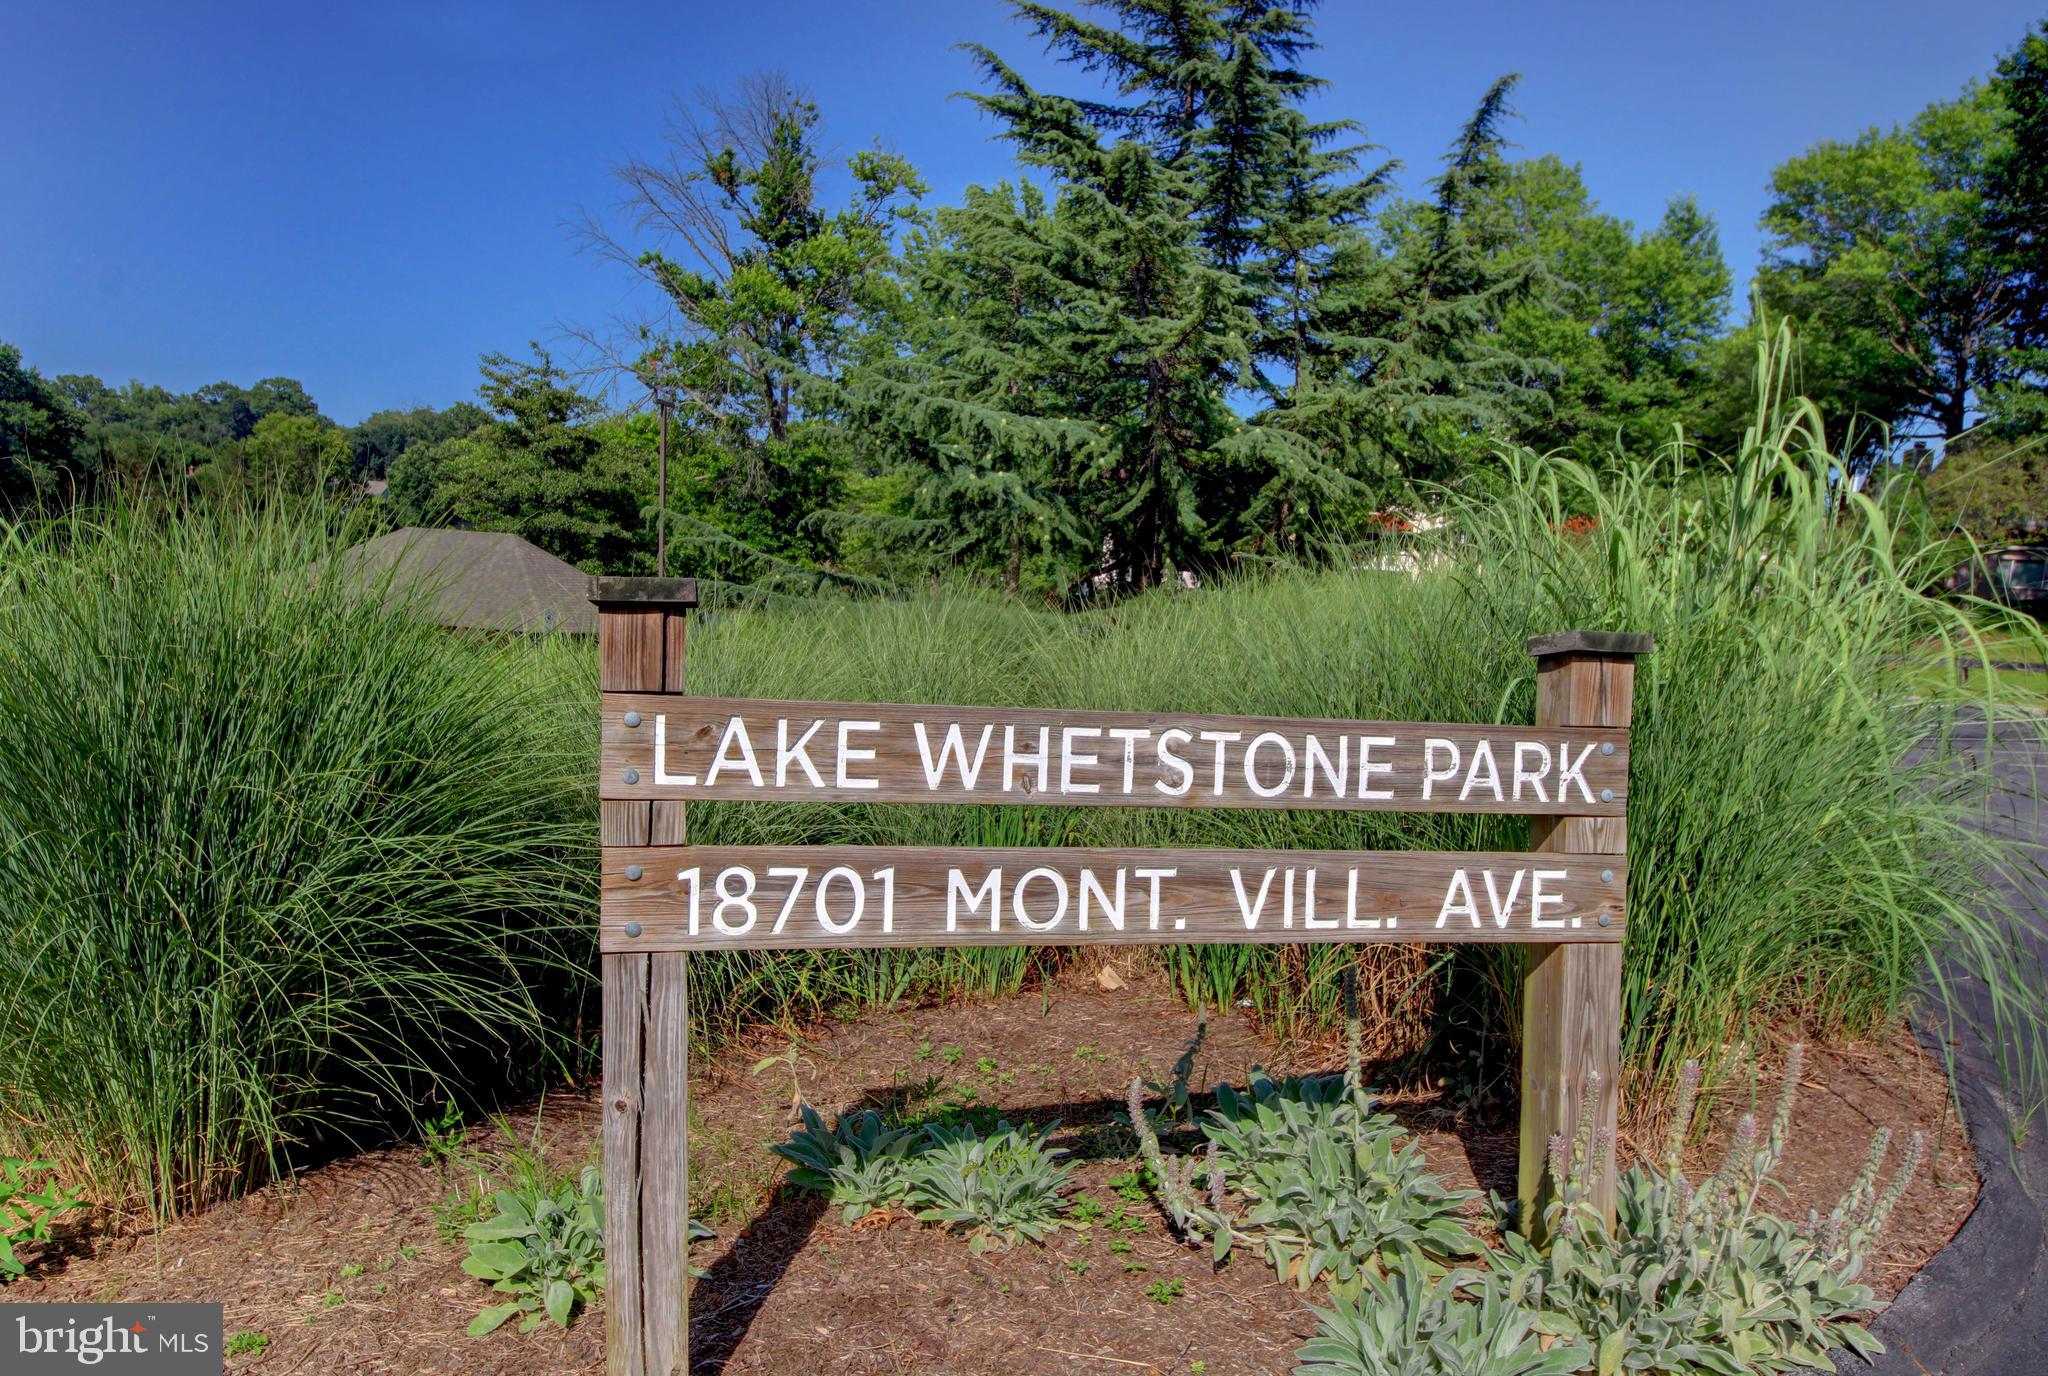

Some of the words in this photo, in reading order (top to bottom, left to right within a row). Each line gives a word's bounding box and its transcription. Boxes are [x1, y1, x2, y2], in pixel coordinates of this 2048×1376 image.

[653, 713, 881, 789] LAKE
[913, 720, 1396, 800] WHETSTONE
[1421, 738, 1598, 804] PARK
[676, 865, 895, 937] 18701
[946, 867, 1186, 933] MONT.
[1229, 866, 1398, 931] VILL.
[1434, 868, 1583, 930] AVE.
